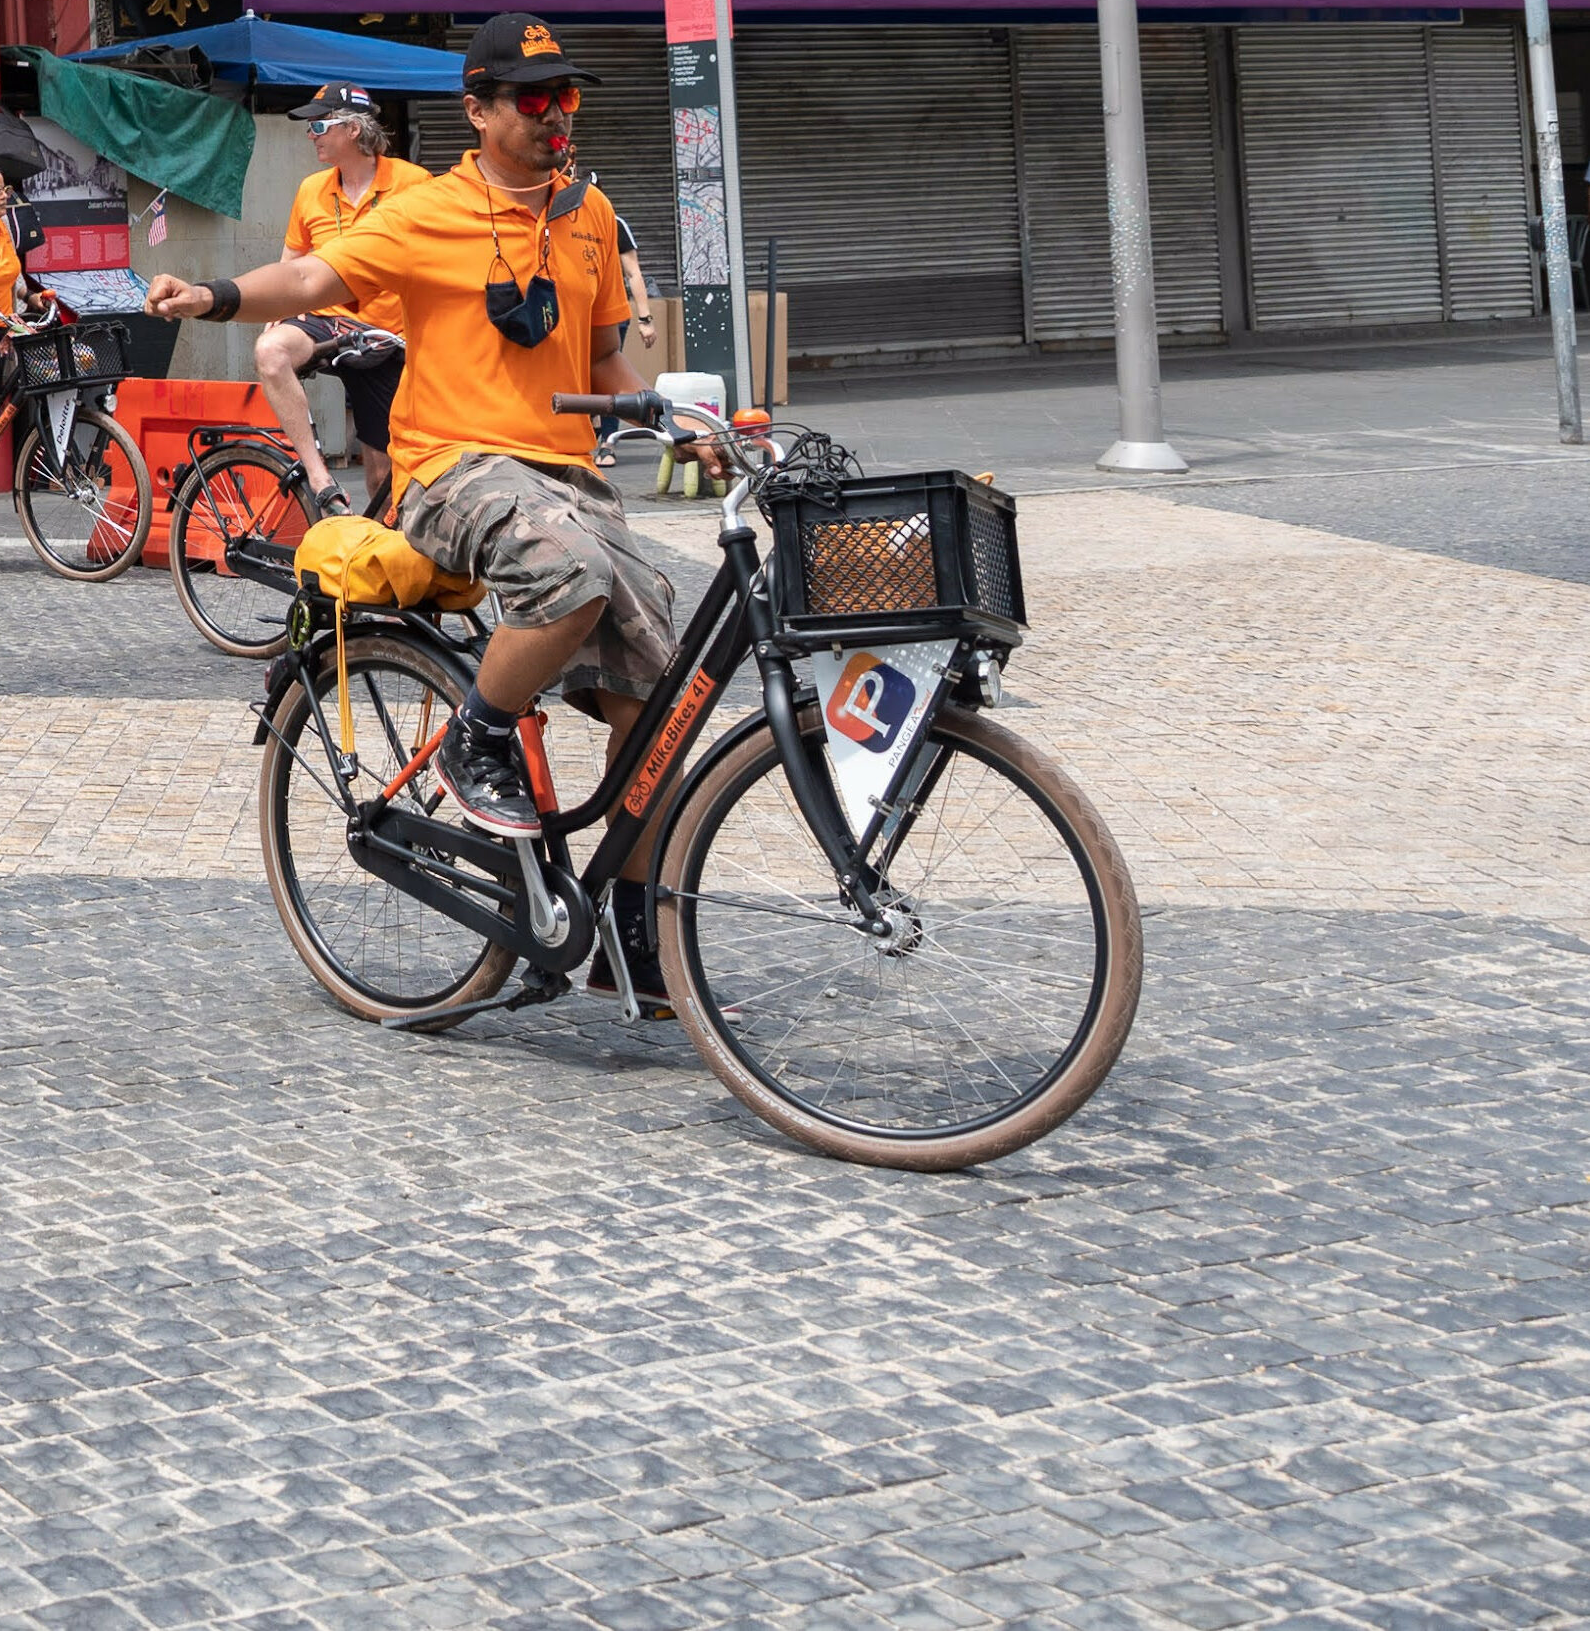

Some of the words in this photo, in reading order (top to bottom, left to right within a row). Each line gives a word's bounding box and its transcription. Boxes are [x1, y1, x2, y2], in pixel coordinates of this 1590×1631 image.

[57, 399, 71, 445] Deloitte
[649, 702, 696, 778] MikeBikes
[692, 675, 712, 697] 41
[838, 670, 892, 738] P
[888, 716, 920, 768] PANGEA
